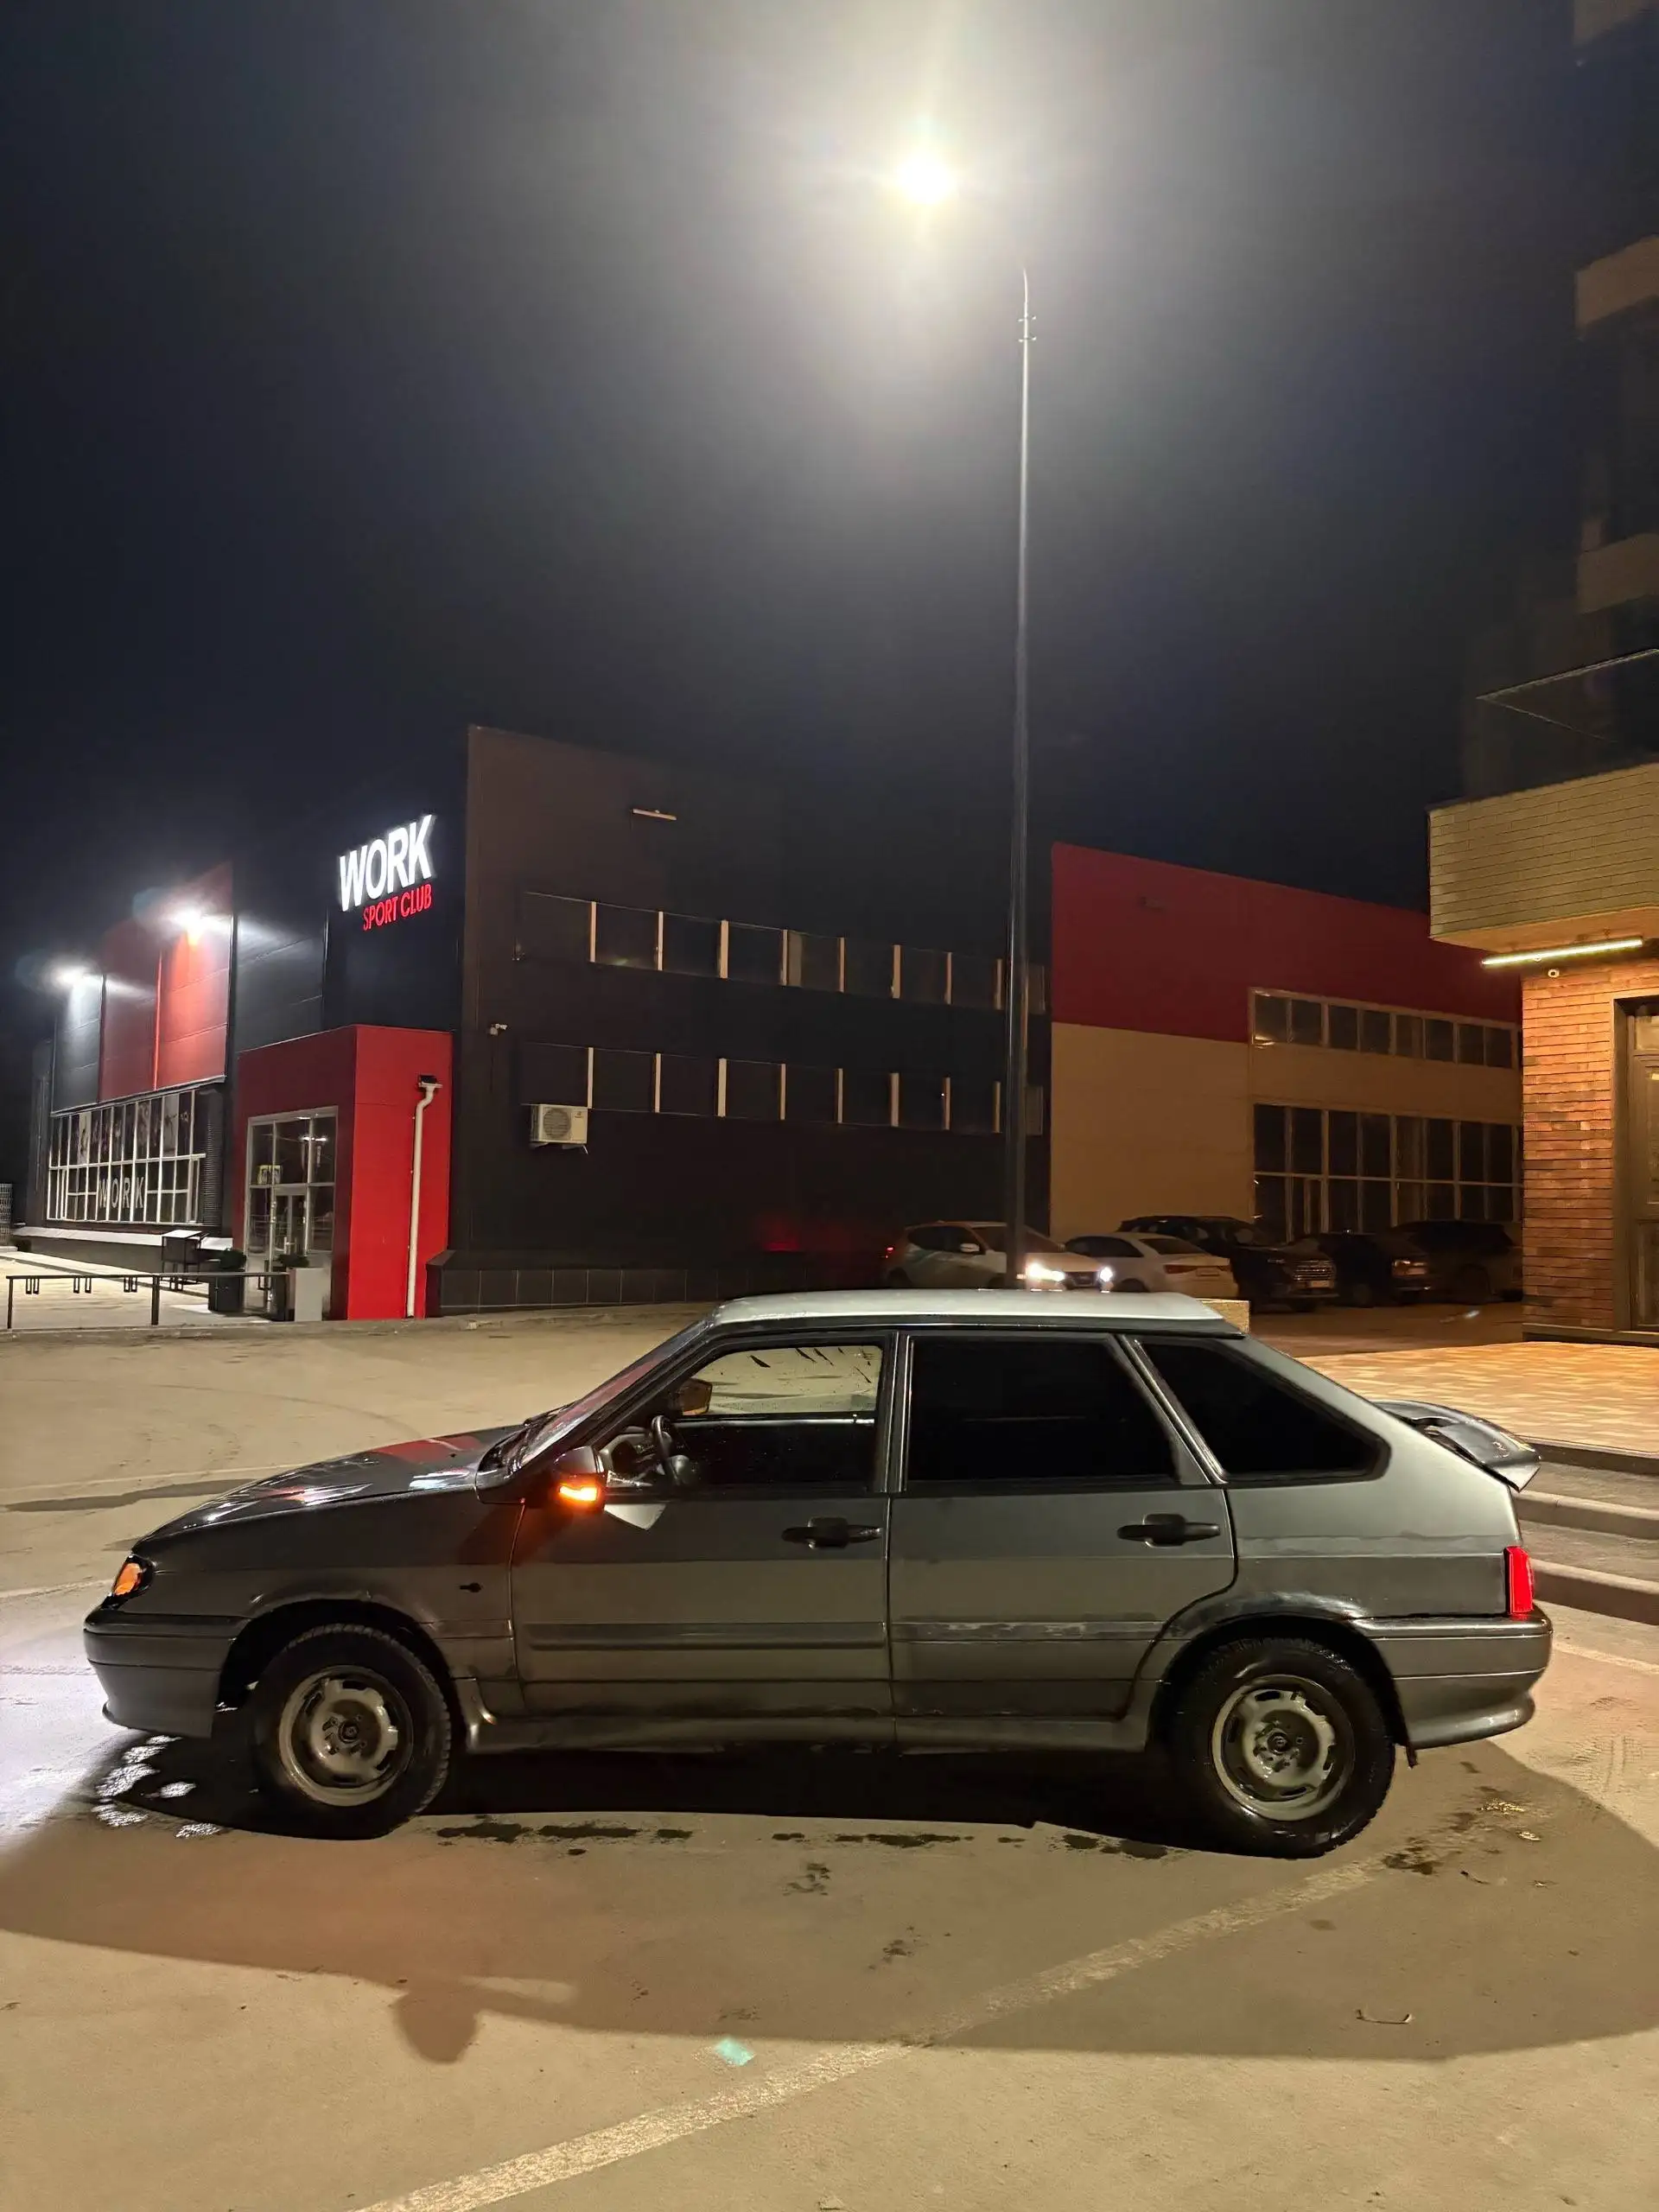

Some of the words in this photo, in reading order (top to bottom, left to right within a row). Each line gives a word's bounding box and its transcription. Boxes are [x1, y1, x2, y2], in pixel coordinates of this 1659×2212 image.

[340, 814, 433, 912] WORK
[363, 896, 398, 931] SPORT
[400, 884, 432, 918] CLUB
[99, 1177, 144, 1208] WORK
